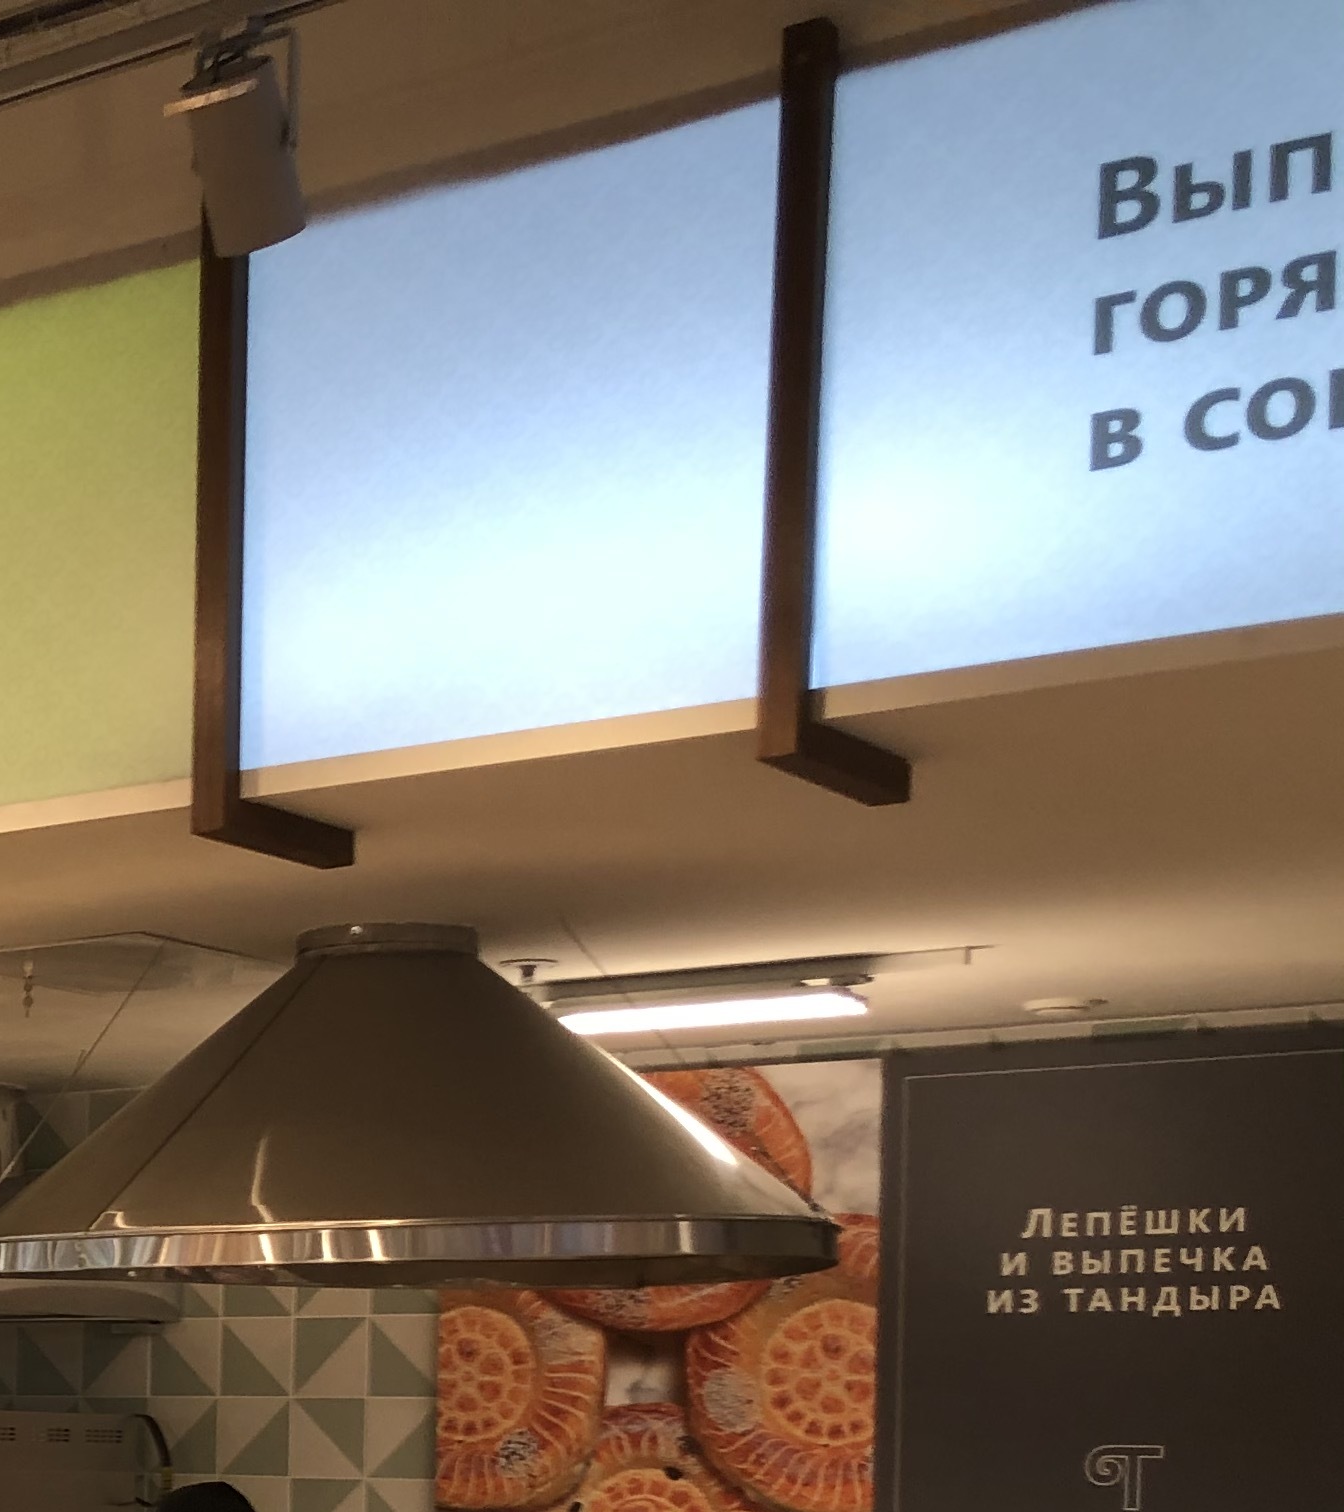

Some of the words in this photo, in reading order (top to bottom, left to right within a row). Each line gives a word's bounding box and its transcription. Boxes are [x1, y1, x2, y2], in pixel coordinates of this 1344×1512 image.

[1052, 1244, 1269, 1276] ВЫПЕЧКА
[986, 1288, 1040, 1314] ИЗ
[1061, 1284, 1282, 1318] ТАНДЫРА
